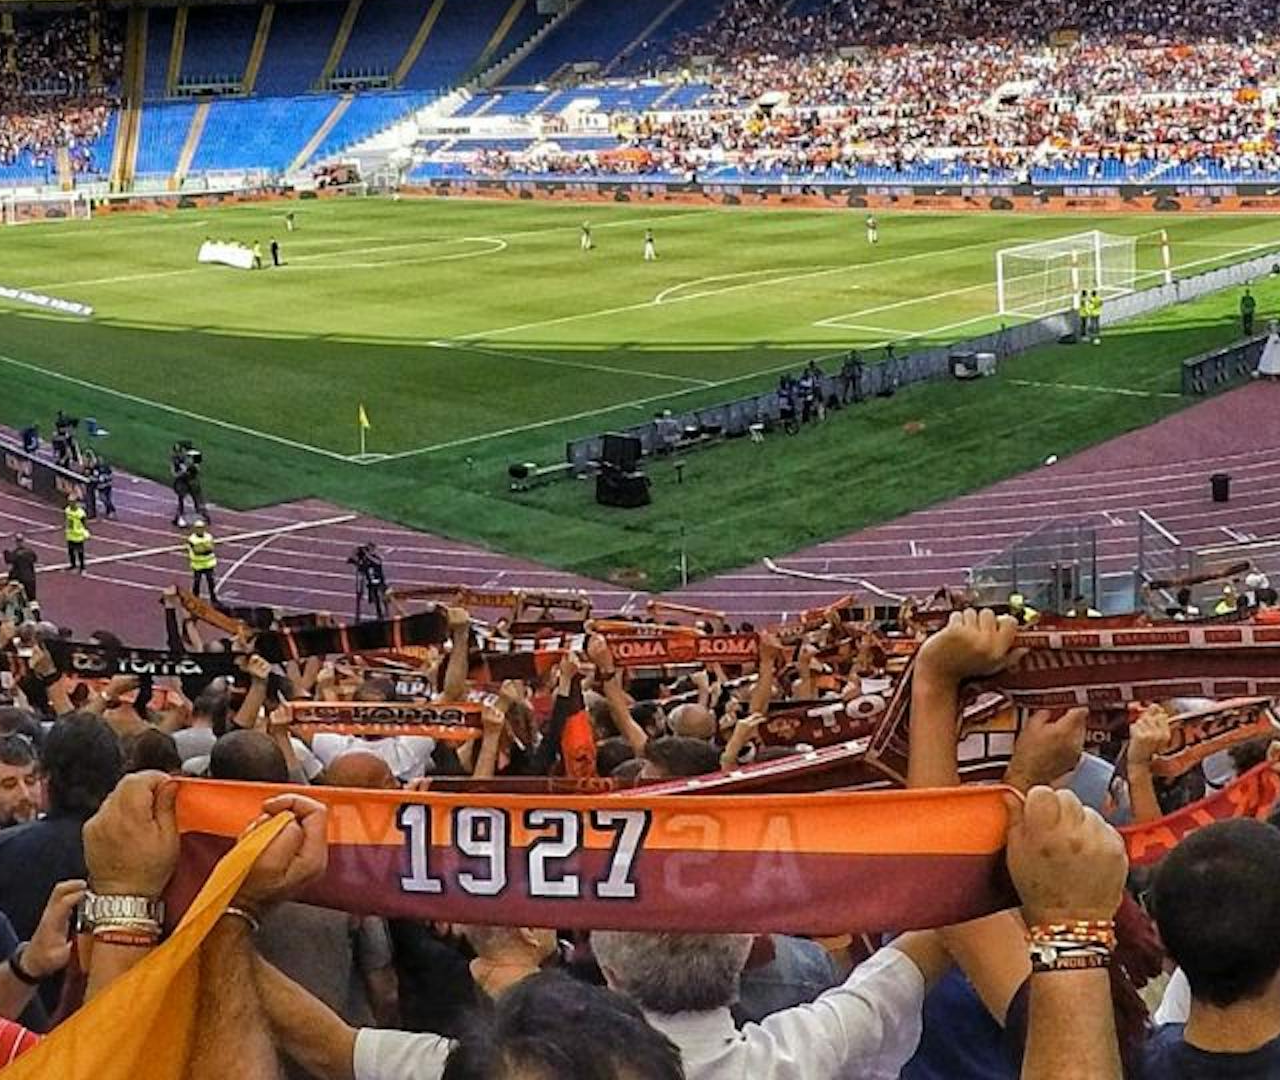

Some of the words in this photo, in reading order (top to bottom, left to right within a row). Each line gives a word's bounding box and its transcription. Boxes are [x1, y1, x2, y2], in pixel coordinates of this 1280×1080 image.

[698, 637, 758, 656] ROMA
[353, 705, 465, 725] roma
[395, 802, 654, 900] 1927
